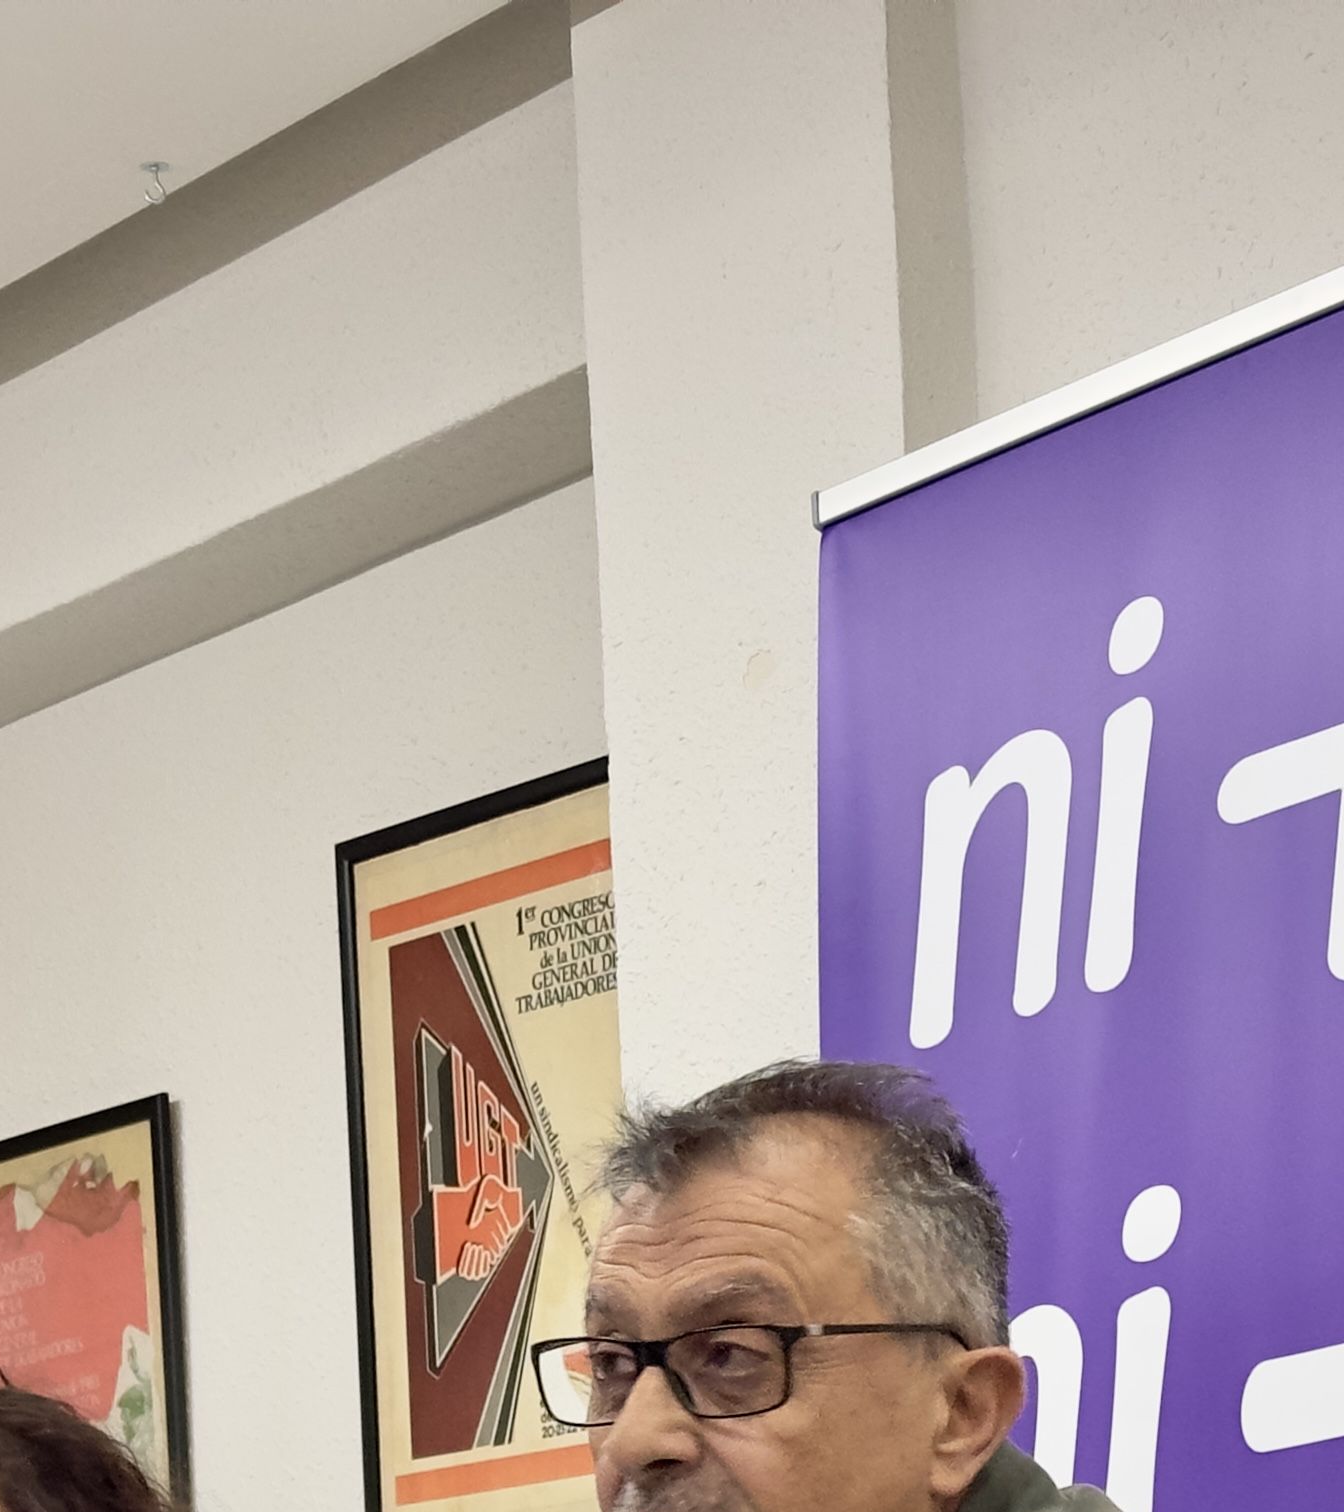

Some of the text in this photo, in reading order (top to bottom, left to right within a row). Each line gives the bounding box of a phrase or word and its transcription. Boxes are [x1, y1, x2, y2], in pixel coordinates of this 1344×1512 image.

[909, 595, 1165, 1050] ni
[532, 957, 597, 991] GENERAL
[540, 950, 554, 969] de
[557, 947, 568, 965] la
[451, 1043, 522, 1190] UGT
[530, 1081, 592, 1258] un sindicalismo para
